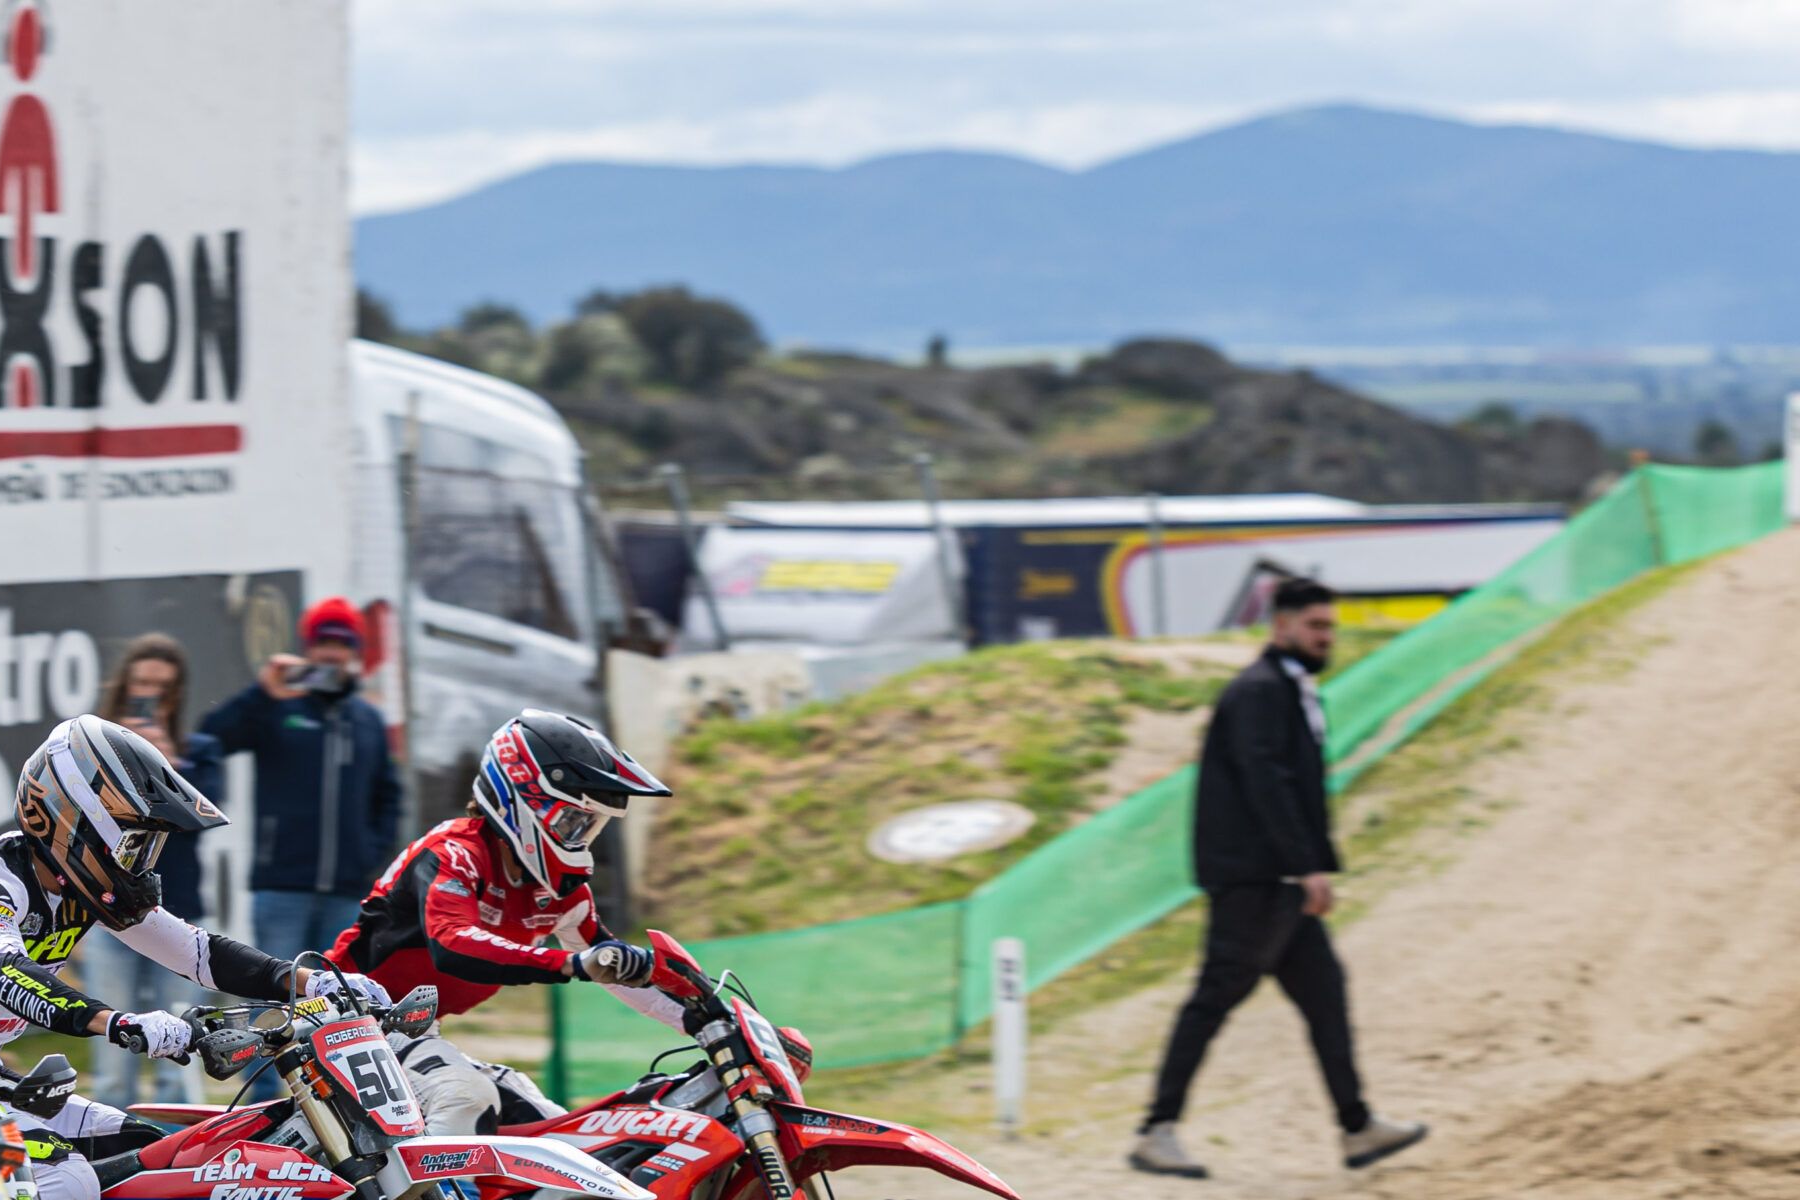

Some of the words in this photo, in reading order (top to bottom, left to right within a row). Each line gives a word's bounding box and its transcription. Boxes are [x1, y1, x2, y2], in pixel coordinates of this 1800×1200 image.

[345, 1048, 408, 1111] 50
[576, 1109, 712, 1143] DUCATI
[192, 1162, 258, 1182] TEAM
[267, 1160, 334, 1183] JCR
[418, 1151, 471, 1168] Andreani
[423, 1161, 468, 1174] MHS
[513, 1158, 598, 1190] EUROMOTO
